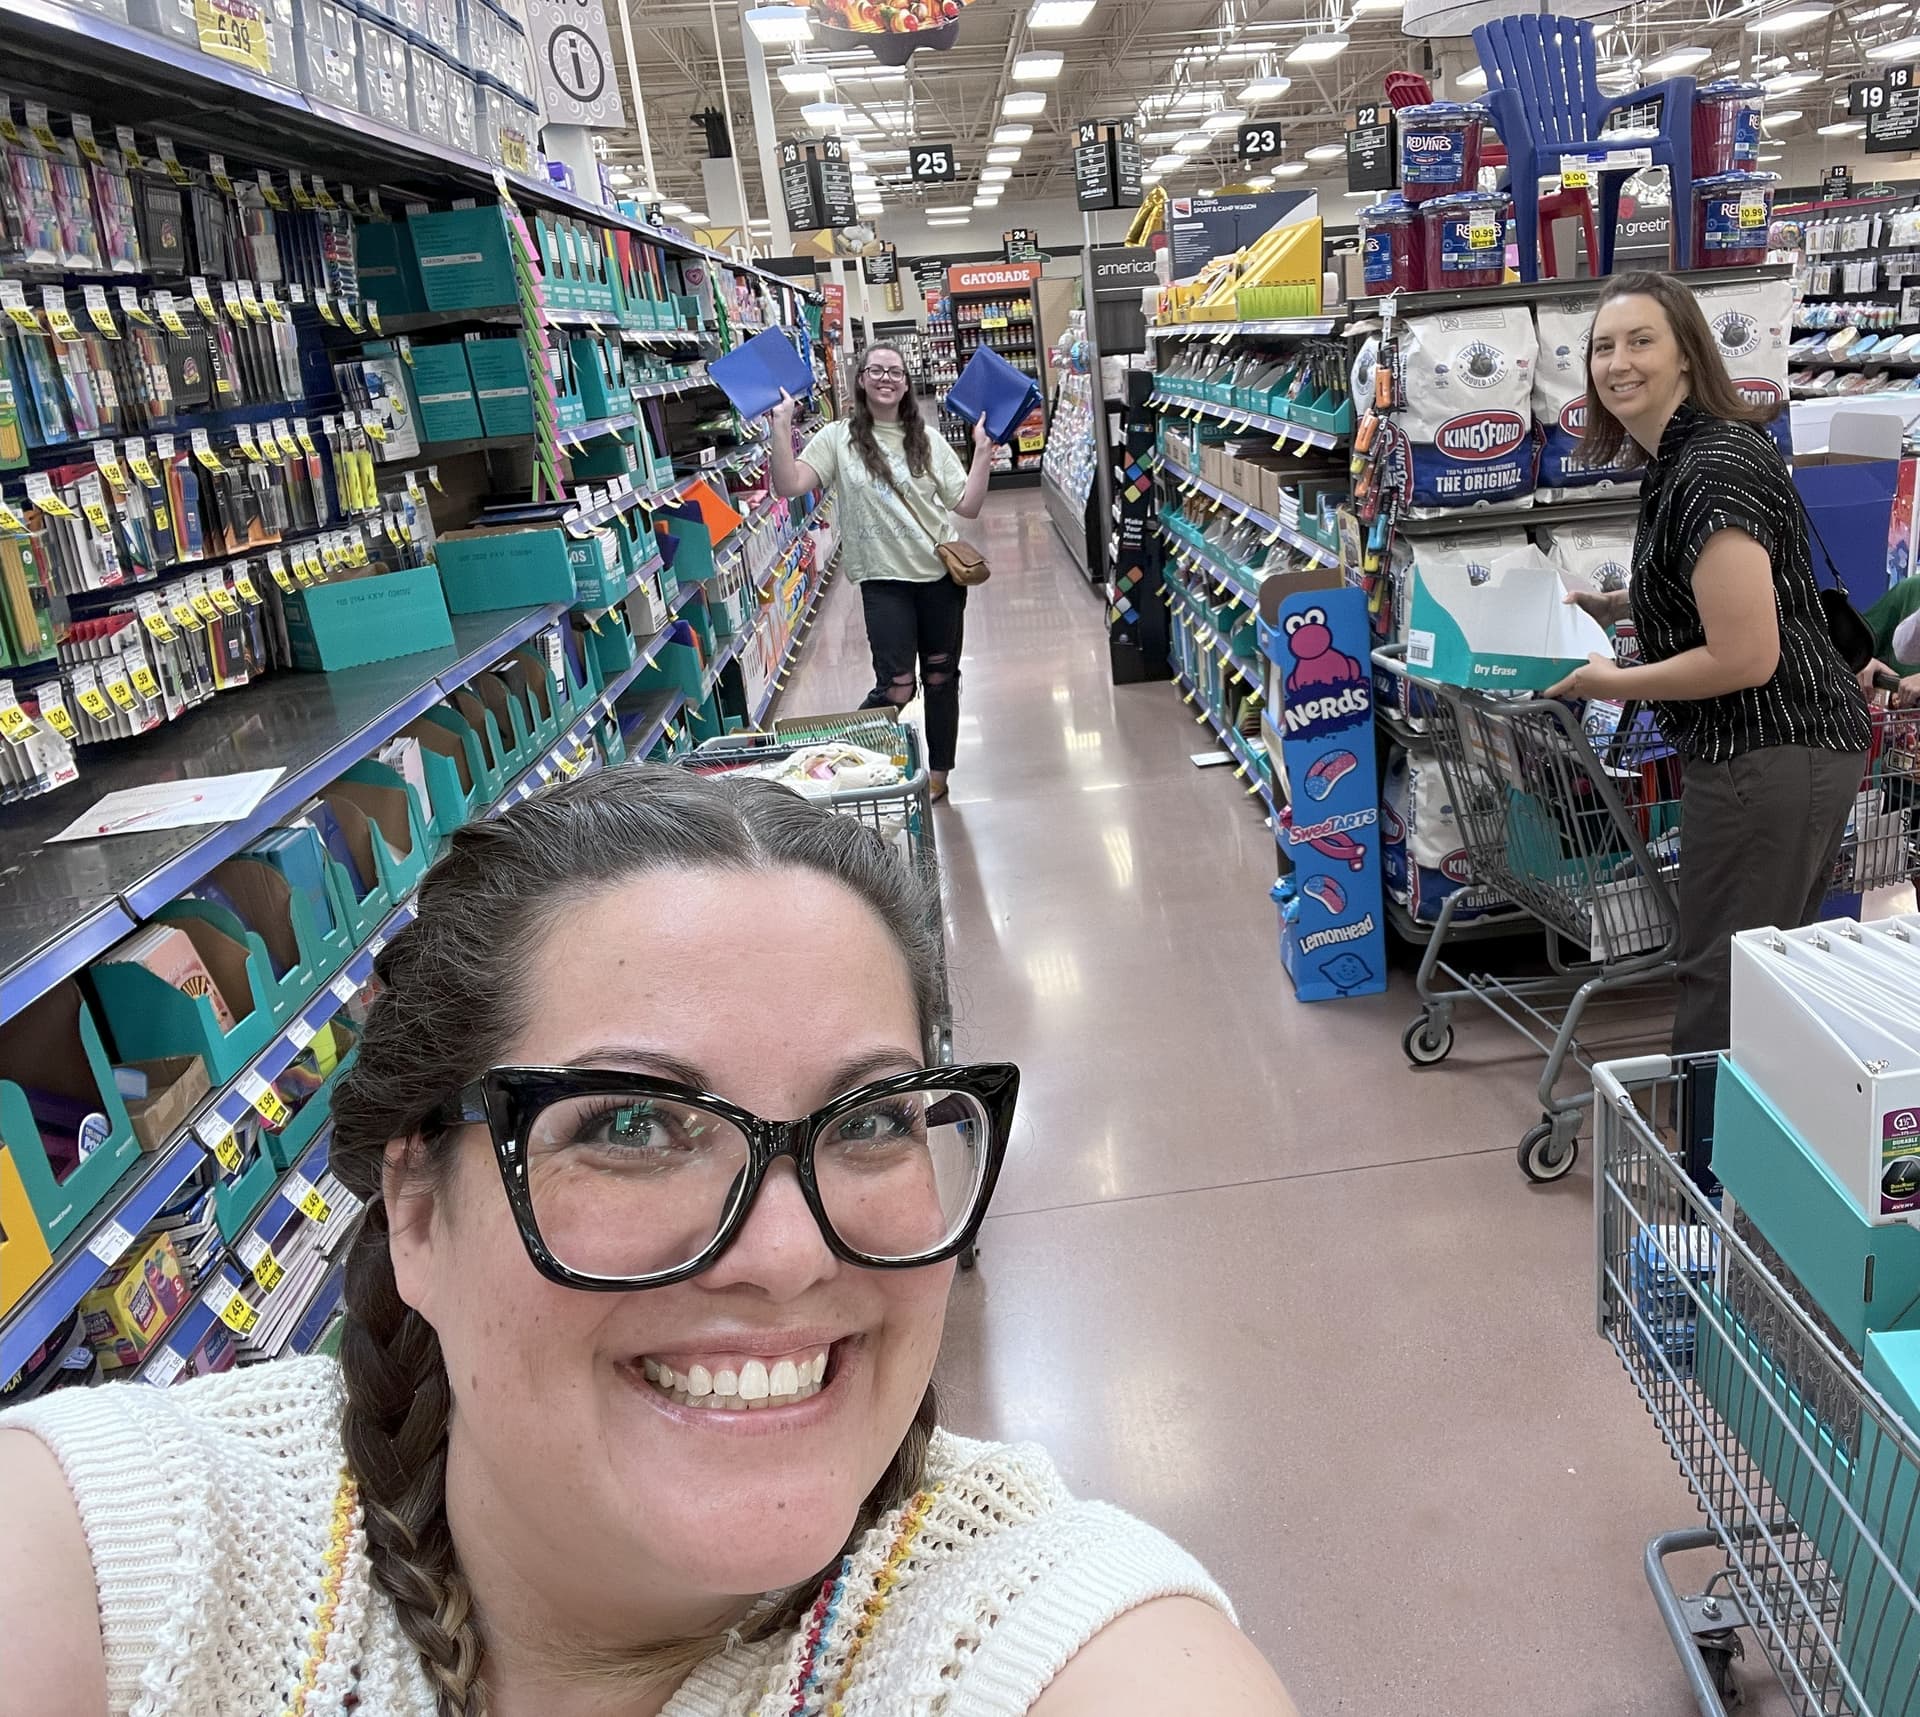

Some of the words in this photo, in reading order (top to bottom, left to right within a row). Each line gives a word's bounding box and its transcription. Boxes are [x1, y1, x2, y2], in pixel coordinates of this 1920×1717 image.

[218, 14, 251, 53] 6.99
[1890, 69, 1907, 86] 18
[1860, 86, 1883, 108] 19
[1358, 107, 1375, 125] 22
[1081, 124, 1095, 142] 24
[1123, 122, 1134, 138] 24
[826, 141, 841, 158] 26
[1246, 130, 1276, 153] 23
[783, 144, 797, 162] 26
[916, 151, 948, 175] 25
[1834, 167, 1844, 176] 12
[1564, 172, 1586, 182] 9.00
[1741, 208, 1763, 218] 10.99
[1014, 231, 1026, 240] 24
[1470, 228, 1494, 239] 10.99
[960, 269, 1031, 286] GATORADE
[1444, 419, 1520, 453] KINGSFORD
[1436, 475, 1461, 494] THE
[1464, 467, 1522, 490] ORIGINAL
[87, 507, 103, 521] 2.99
[1474, 664, 1490, 675] Dry
[1491, 664, 1518, 676] Erase
[0, 713, 23, 729] 1.49
[258, 1092, 275, 1113] 3.99
[218, 1136, 233, 1155] 1.00
[1892, 1136, 1918, 1146] DURABLE
[303, 1193, 320, 1215] 3.49
[256, 1254, 272, 1281] 2.99
[225, 1299, 245, 1324] 1.49
